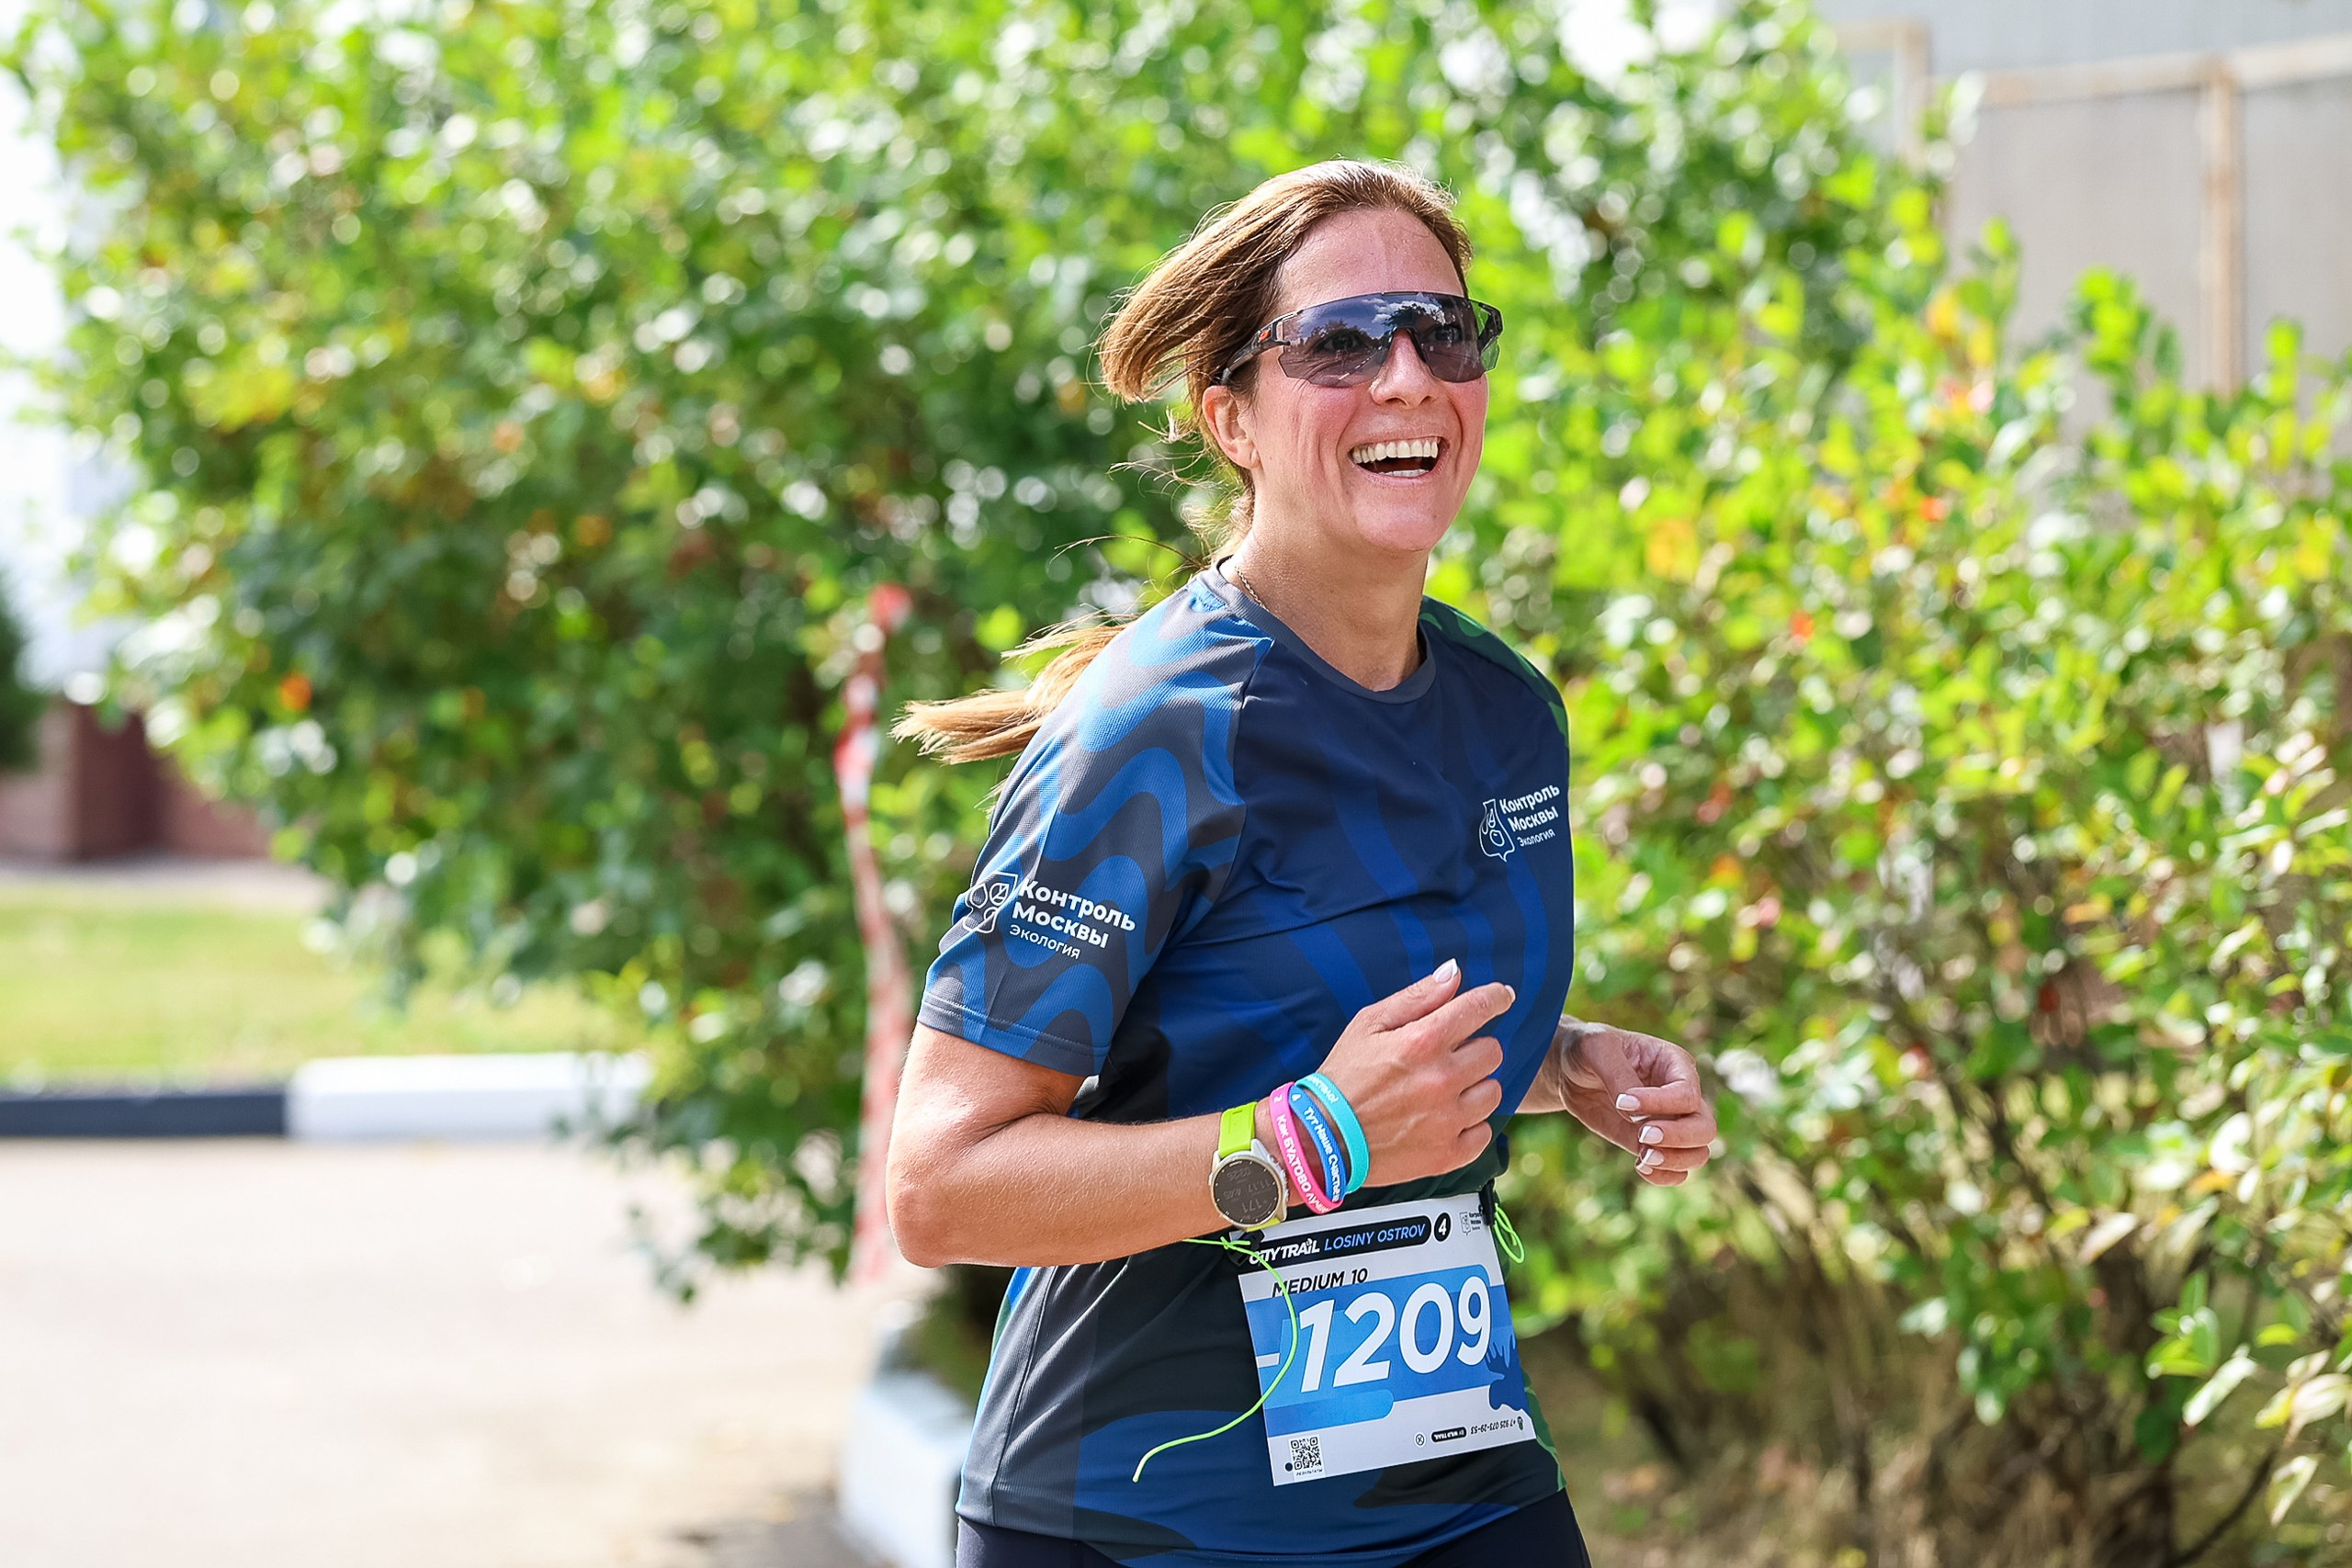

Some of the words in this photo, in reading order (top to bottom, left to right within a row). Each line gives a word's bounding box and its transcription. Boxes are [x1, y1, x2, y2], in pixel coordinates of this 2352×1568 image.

[1499, 784, 1560, 815] Контроль
[1507, 806, 1559, 832] Москвы
[1517, 829, 1556, 847] Экология
[1018, 877, 1136, 931] Контроль
[1009, 924, 1080, 960] Экология
[1012, 901, 1110, 948] Москвы
[1324, 1231, 1374, 1252] LOSINY
[1377, 1223, 1426, 1243] OSTROV
[1437, 1217, 1447, 1236] 4
[1272, 1270, 1345, 1298] MEDIUM
[1351, 1268, 1368, 1285] 10
[1299, 1275, 1491, 1393] 1209
